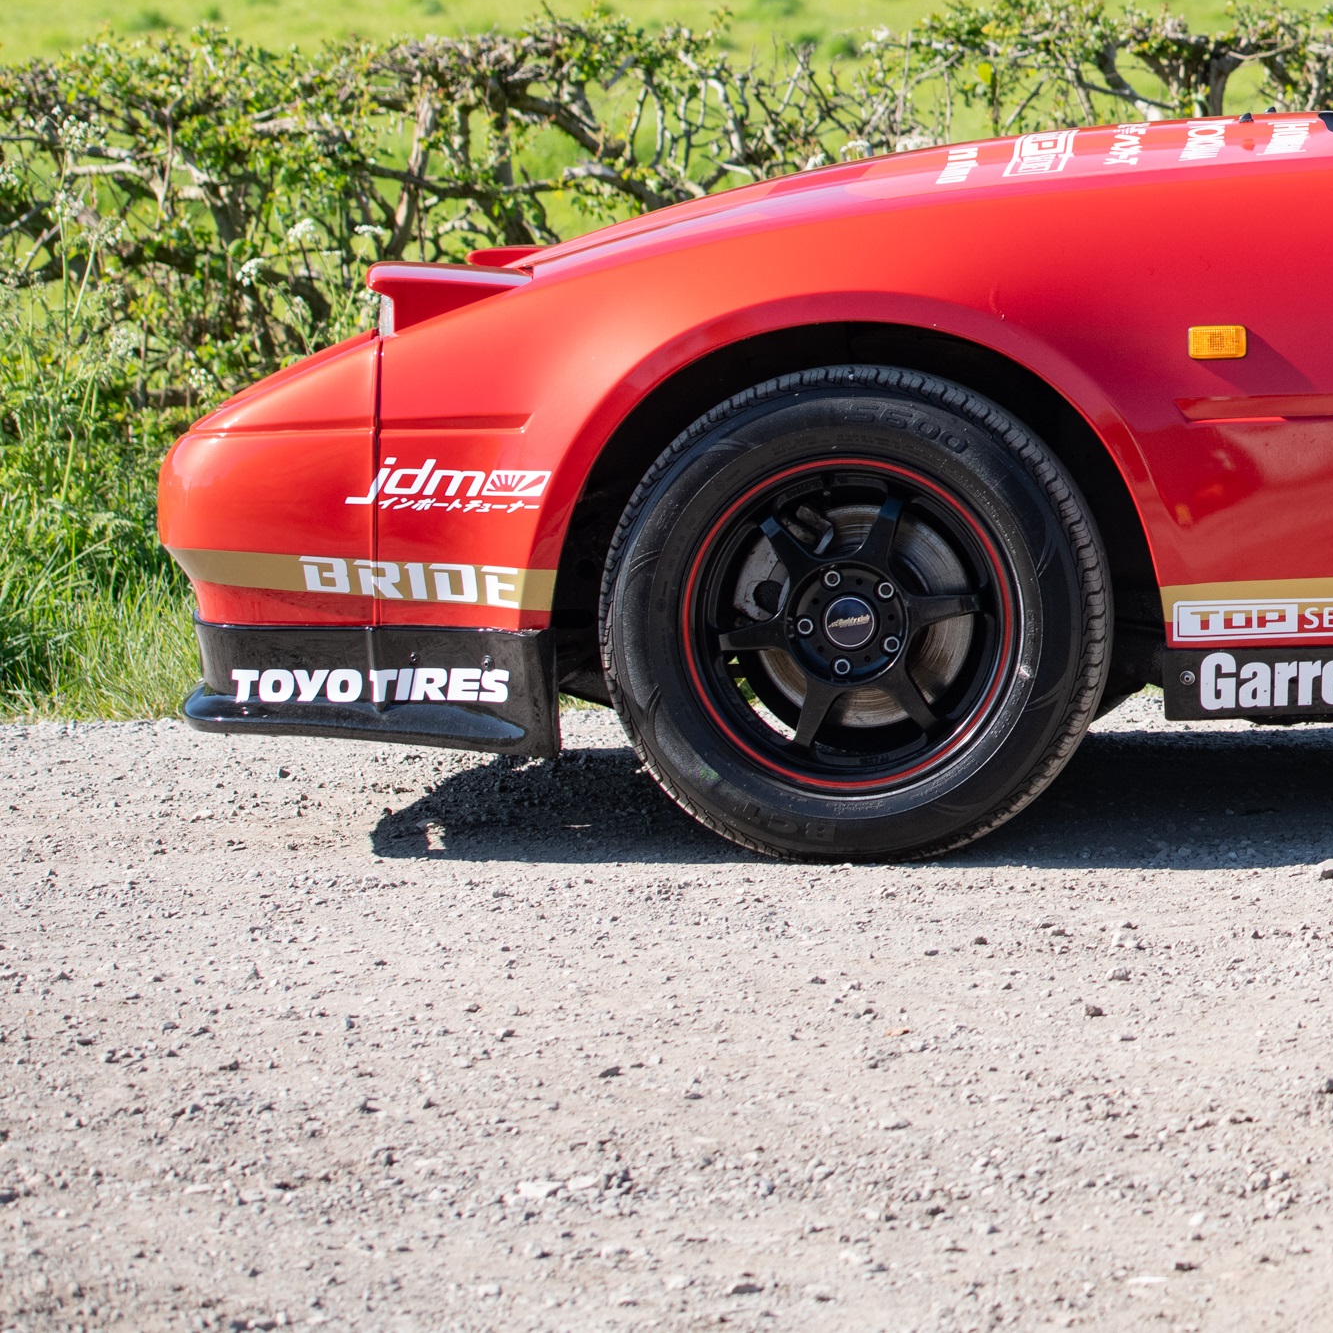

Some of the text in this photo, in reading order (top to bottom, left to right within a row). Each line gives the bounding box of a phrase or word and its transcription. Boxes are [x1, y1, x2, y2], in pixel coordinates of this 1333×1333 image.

[344, 456, 487, 505] jdm
[378, 496, 541, 514] インポートチューナー
[299, 555, 520, 608] BRIDE
[1188, 608, 1288, 631] TOP
[231, 668, 510, 703] TOYO TIRES
